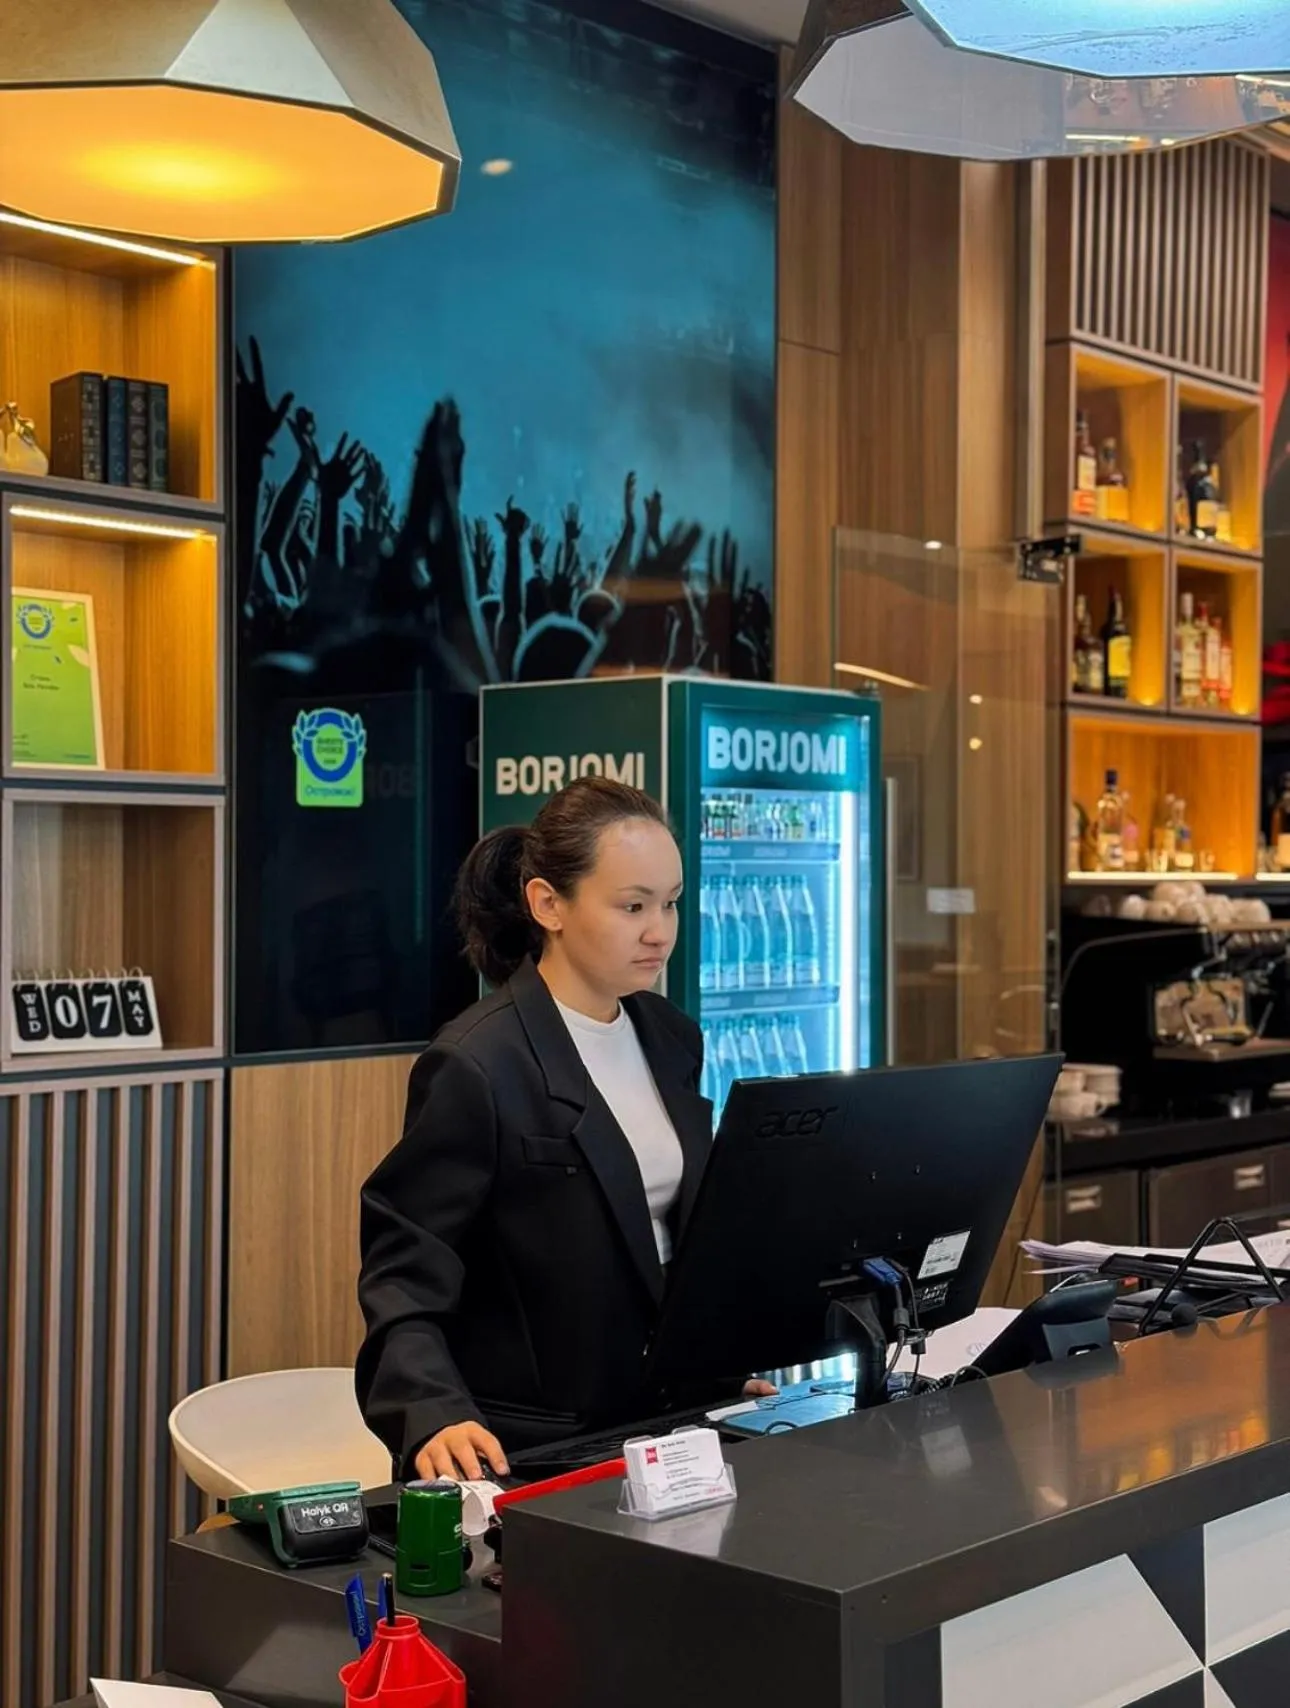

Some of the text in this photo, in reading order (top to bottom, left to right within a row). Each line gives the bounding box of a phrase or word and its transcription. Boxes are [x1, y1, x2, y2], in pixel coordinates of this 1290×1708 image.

[708, 726, 846, 775] BORJOMI
[21, 993, 42, 1033] WED
[127, 990, 145, 1028] MAY
[755, 1105, 839, 1138] acer
[301, 1502, 349, 1517] Halyk QR
